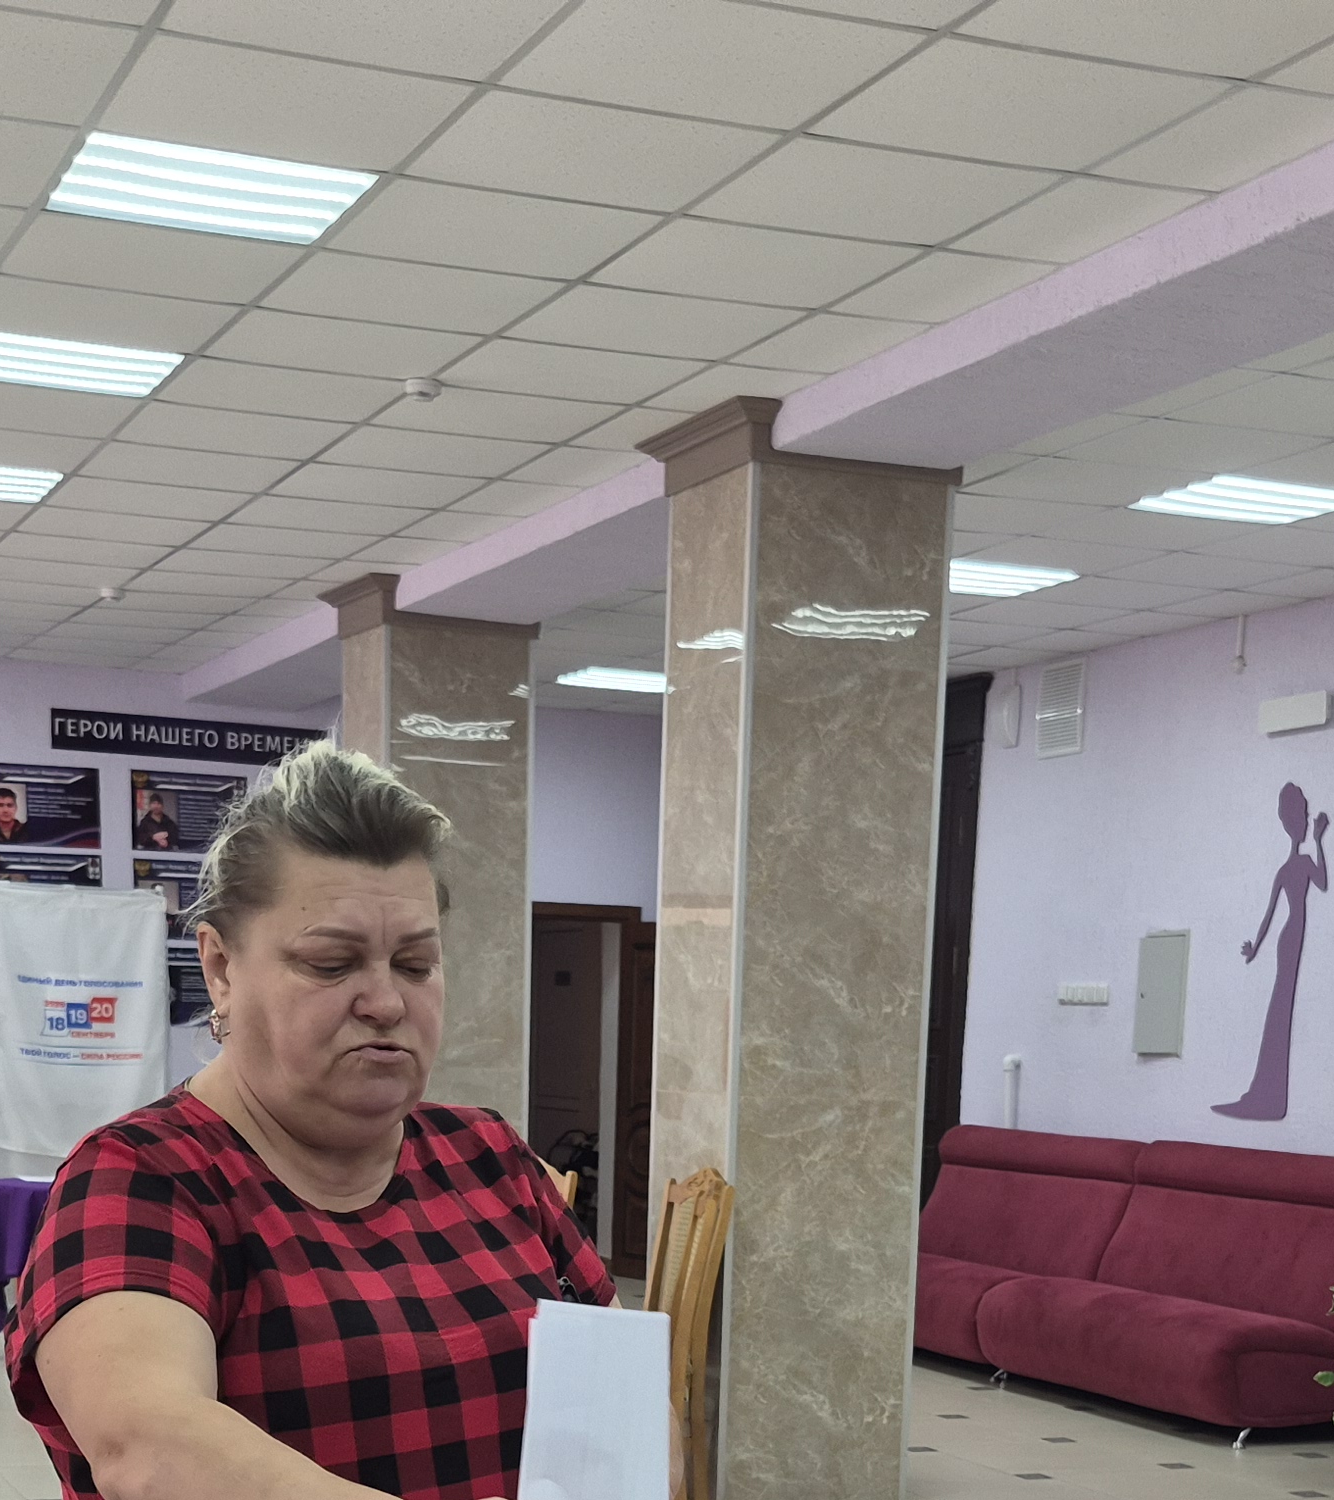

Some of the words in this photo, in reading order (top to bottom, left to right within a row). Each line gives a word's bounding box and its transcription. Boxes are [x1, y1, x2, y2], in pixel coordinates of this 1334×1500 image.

[54, 717, 123, 740] ГЕРОИ
[131, 724, 218, 748] НАШЕГО
[226, 732, 299, 754] ВРЕМЕ
[47, 1016, 66, 1031] 18
[69, 1010, 87, 1024] 19
[91, 1003, 113, 1018] 20
